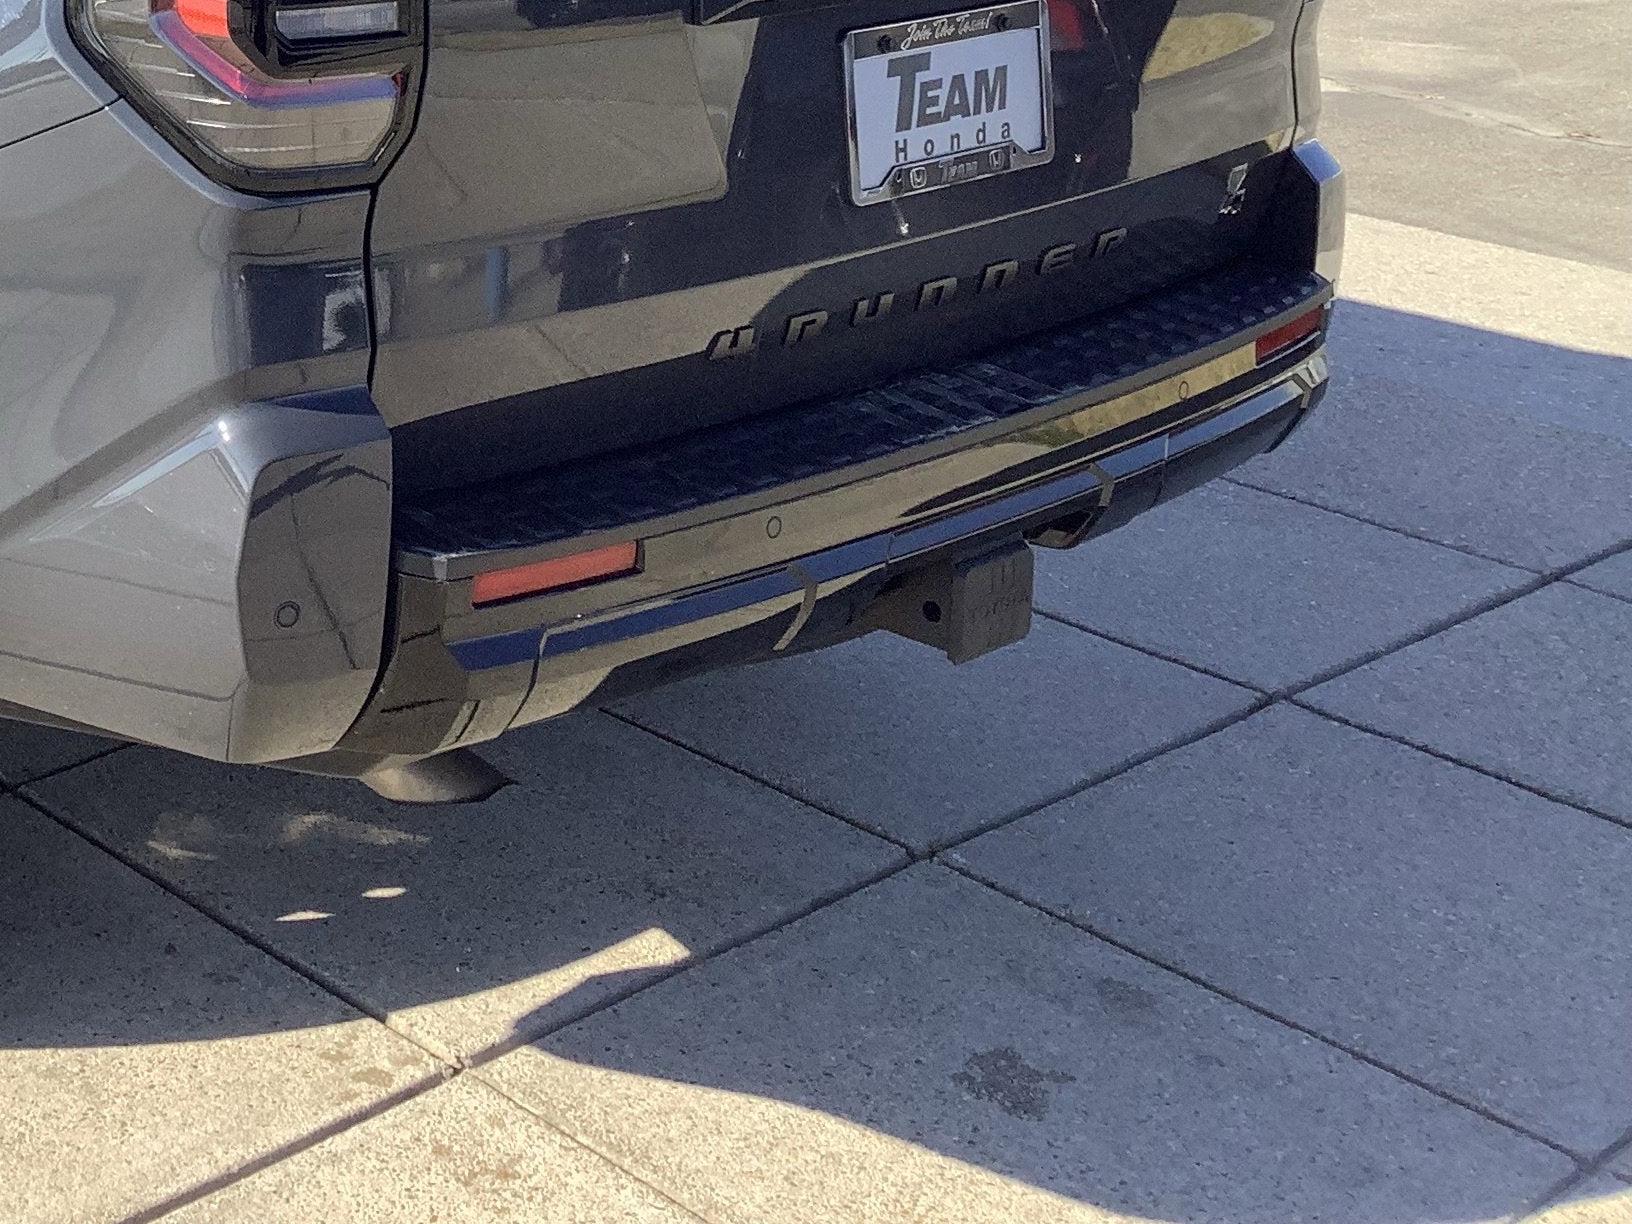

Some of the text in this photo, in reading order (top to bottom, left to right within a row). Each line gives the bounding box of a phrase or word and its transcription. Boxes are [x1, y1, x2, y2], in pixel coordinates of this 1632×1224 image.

[900, 22, 932, 50] Join
[933, 18, 955, 39] The
[886, 51, 1008, 133] TEAM
[895, 121, 1011, 163] Honda
